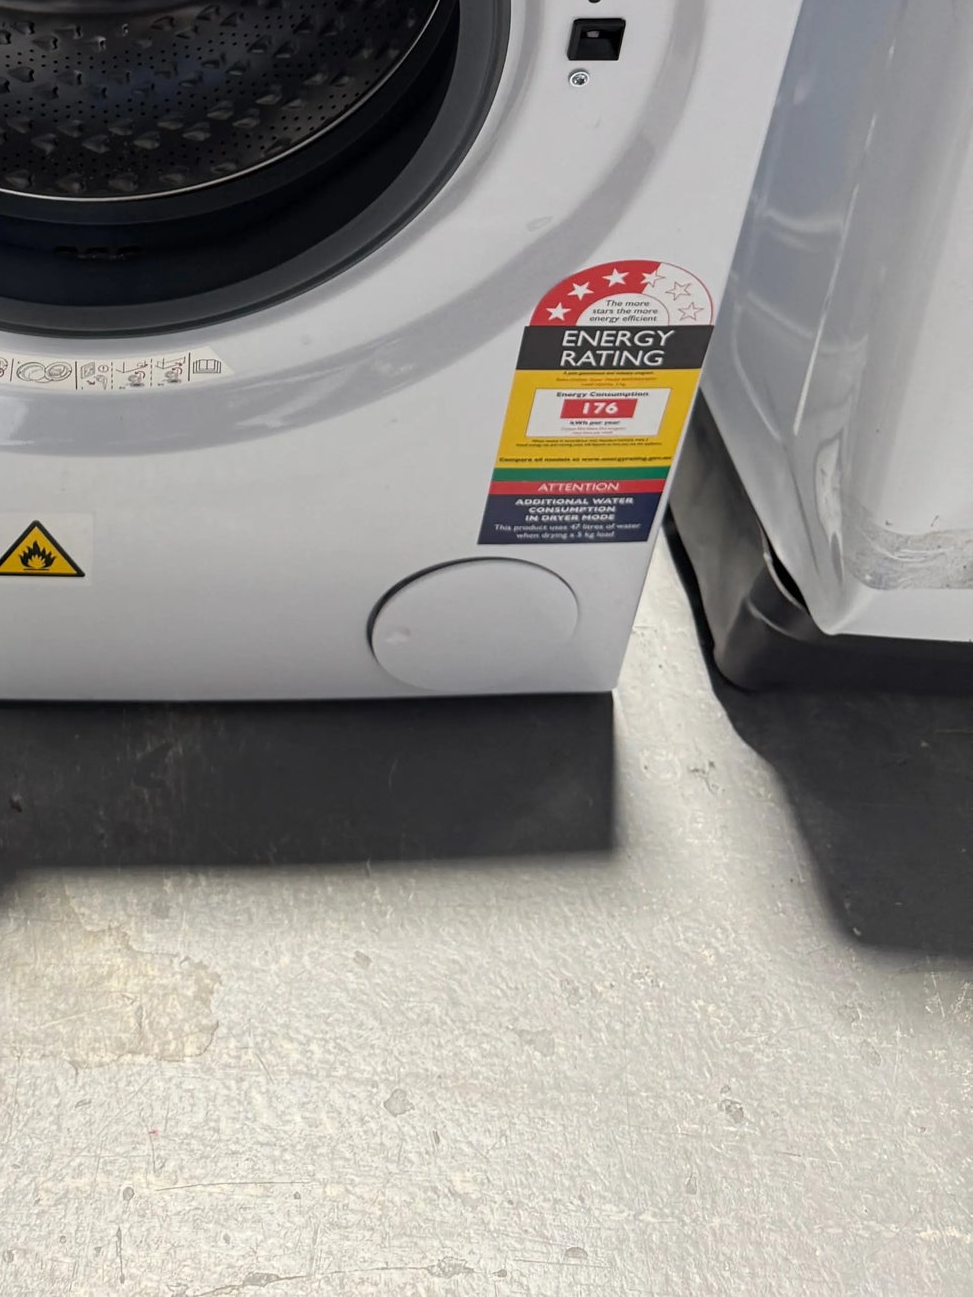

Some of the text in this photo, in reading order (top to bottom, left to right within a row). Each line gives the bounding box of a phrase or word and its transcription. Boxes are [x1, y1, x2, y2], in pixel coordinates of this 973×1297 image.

[562, 330, 676, 347] ENERGY
[560, 350, 666, 366] RATING
[590, 390, 650, 398] Consumption
[582, 402, 619, 415] 176
[538, 482, 620, 492] ATTENTION
[515, 497, 634, 506] ADDITIONAL WATER
[514, 524, 547, 532] product
[542, 532, 567, 540] drying
[584, 532, 595, 540] kg
